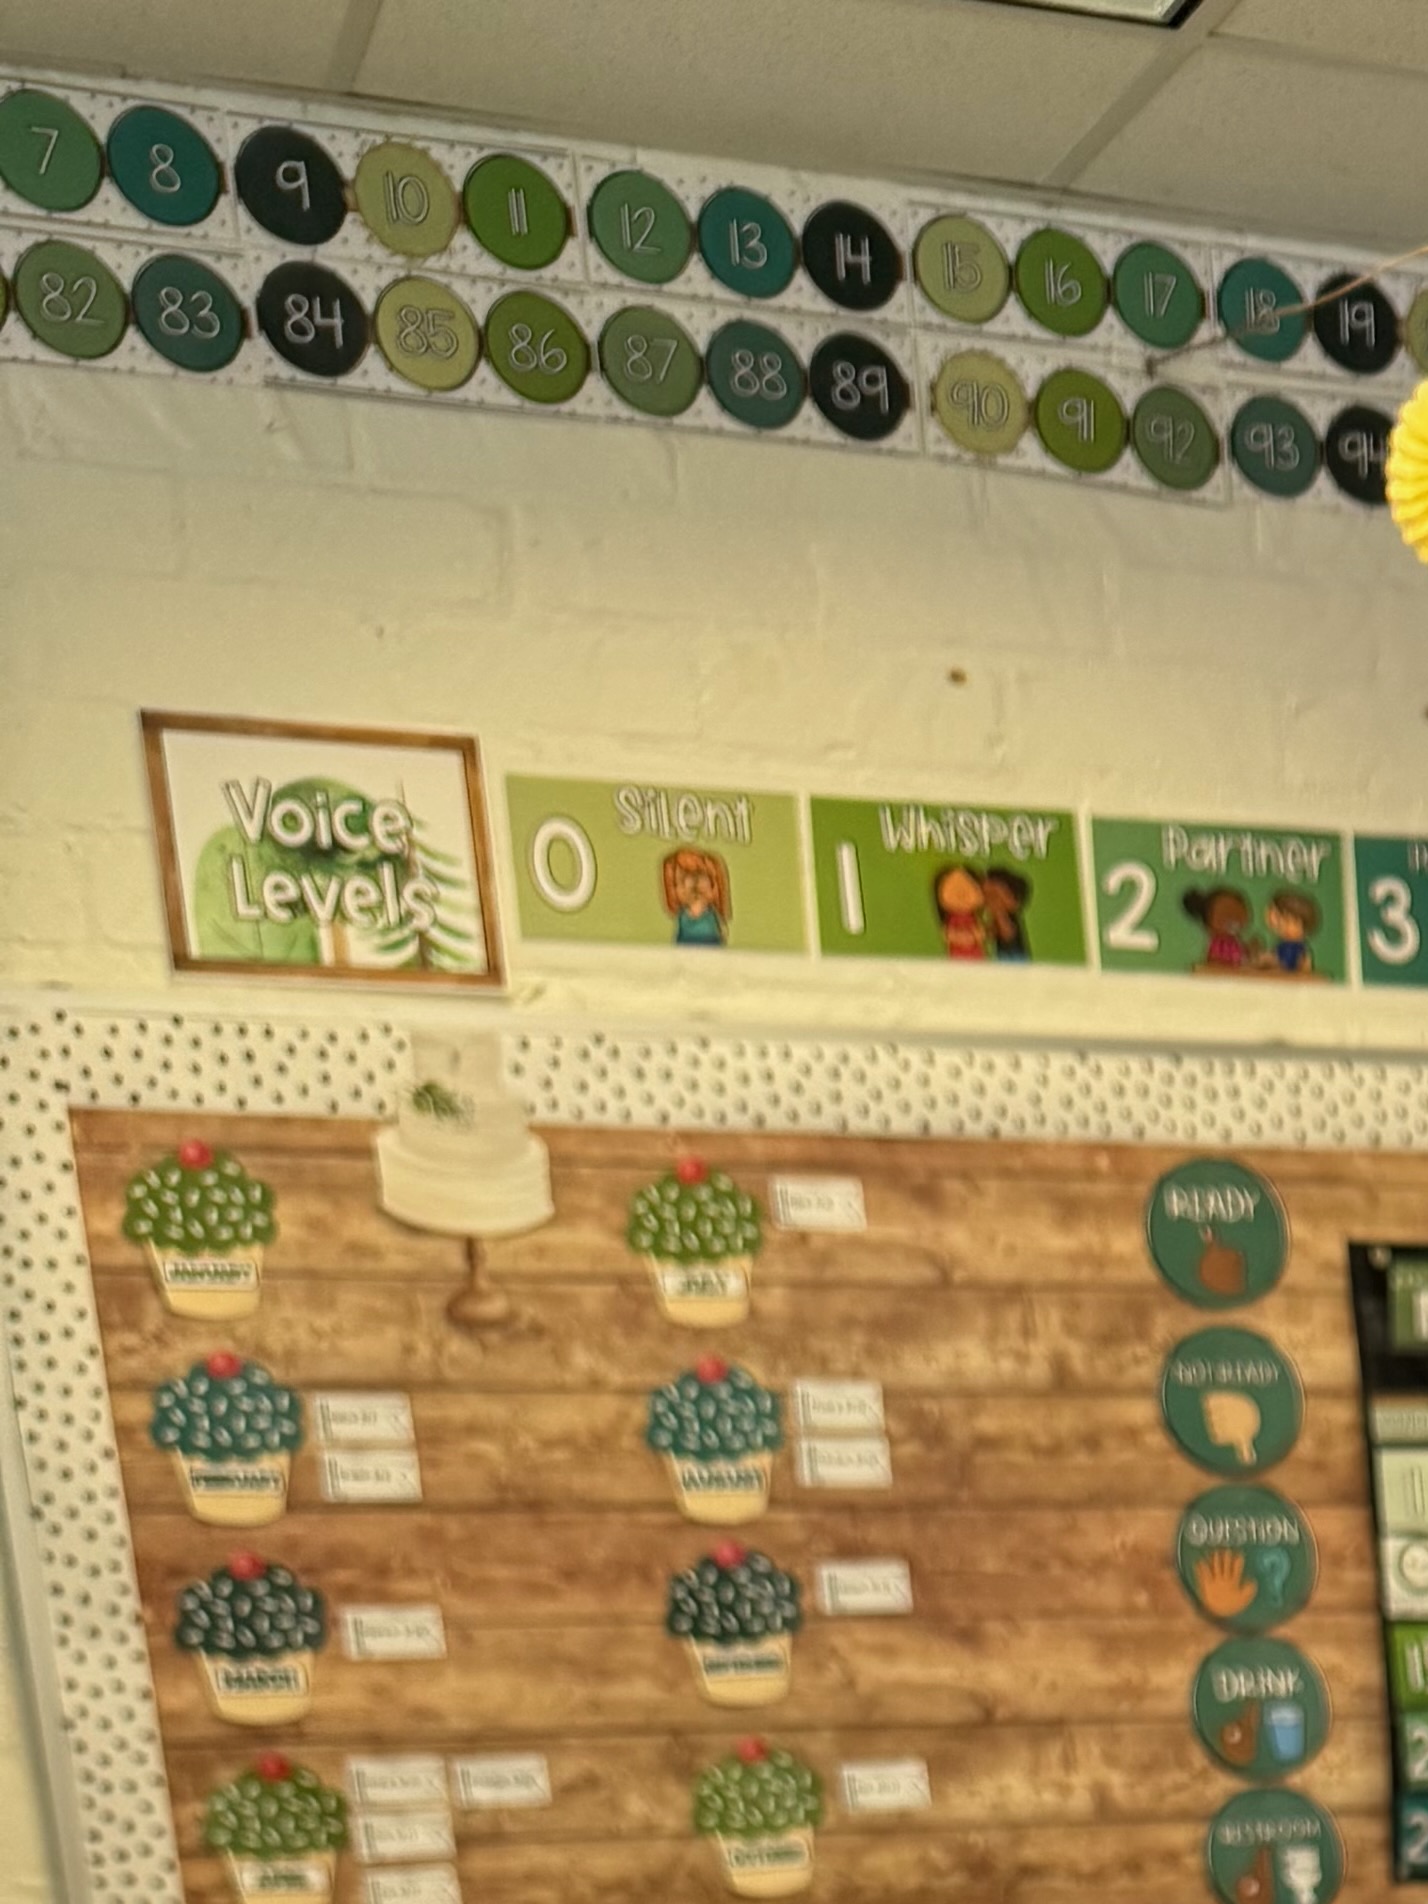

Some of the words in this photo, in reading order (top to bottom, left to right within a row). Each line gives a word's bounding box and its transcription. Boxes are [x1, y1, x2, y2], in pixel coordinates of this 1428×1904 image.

[30, 127, 59, 175] 7
[150, 143, 181, 194] 8
[275, 160, 311, 212] 9
[383, 171, 430, 225] 10
[508, 188, 528, 236] 11
[620, 203, 662, 256] 12
[728, 218, 767, 269] 13
[835, 232, 873, 285] 14
[942, 242, 982, 294] 15
[1044, 257, 1082, 307] 16
[1144, 272, 1177, 318] 17
[1246, 287, 1280, 334] 18
[1339, 298, 1376, 347] 19
[40, 272, 105, 326] 82
[159, 287, 220, 339] 83
[284, 293, 345, 350] 84
[396, 306, 459, 359] 85
[508, 323, 567, 374] 86
[624, 335, 678, 384] 87
[731, 349, 787, 399] 88
[832, 361, 890, 415] 89
[951, 380, 1010, 430] 90
[1058, 397, 1095, 443] 91
[1146, 414, 1195, 465] 92
[1244, 422, 1300, 471] 93
[222, 776, 413, 854] Voice
[229, 854, 438, 931] Levels
[836, 840, 865, 935] 1
[1104, 861, 1159, 952] 2
[1368, 875, 1419, 964] 3
